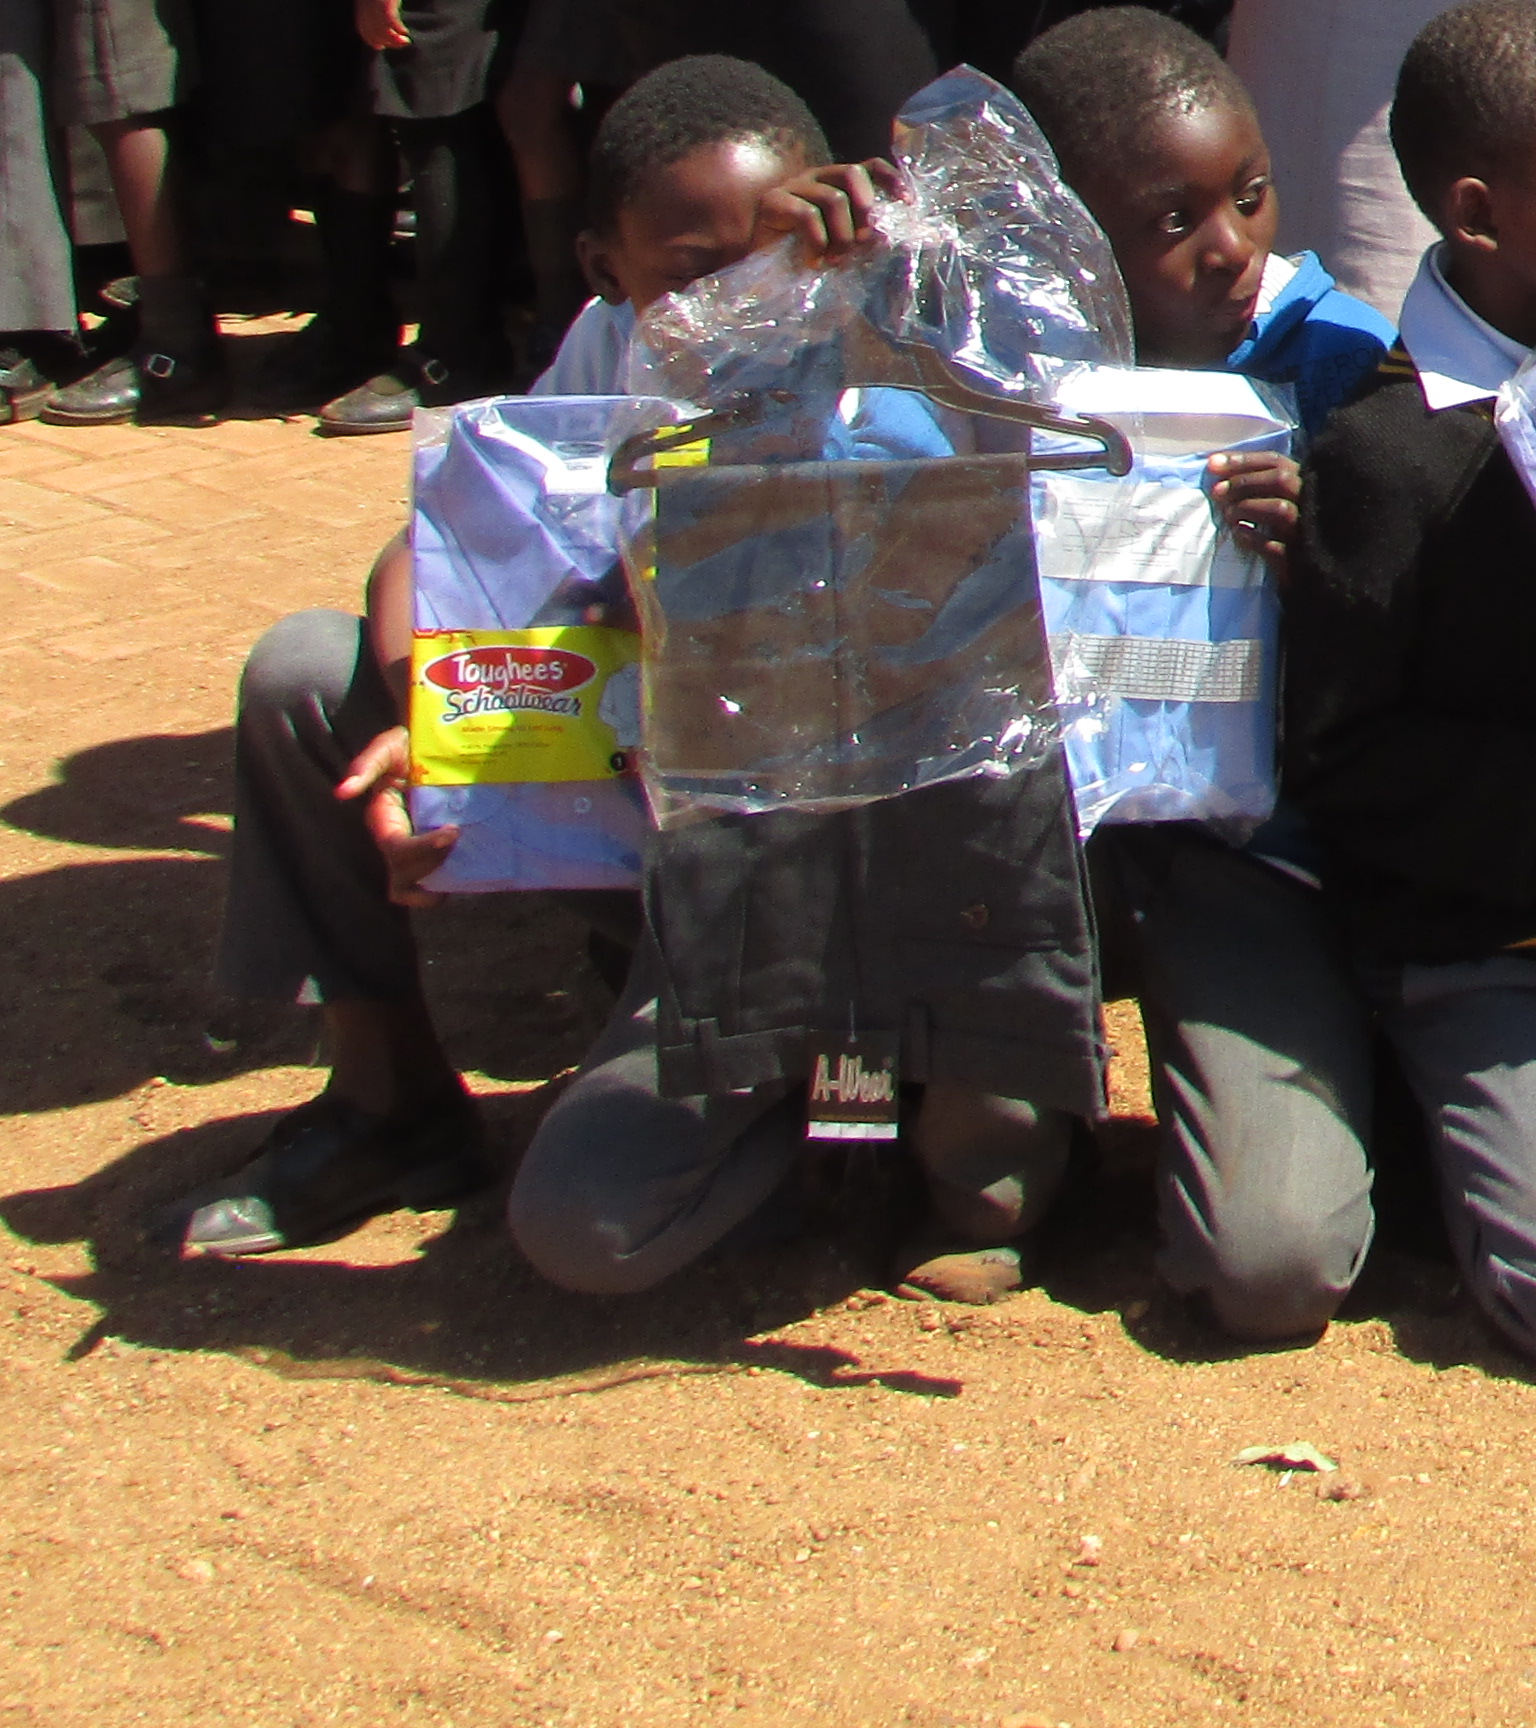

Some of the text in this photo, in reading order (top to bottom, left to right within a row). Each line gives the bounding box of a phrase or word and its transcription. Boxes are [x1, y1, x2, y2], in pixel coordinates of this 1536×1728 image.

[451, 652, 565, 693] Toughees
[441, 684, 582, 723] Schoolwear
[811, 1052, 895, 1103] A-Wear
